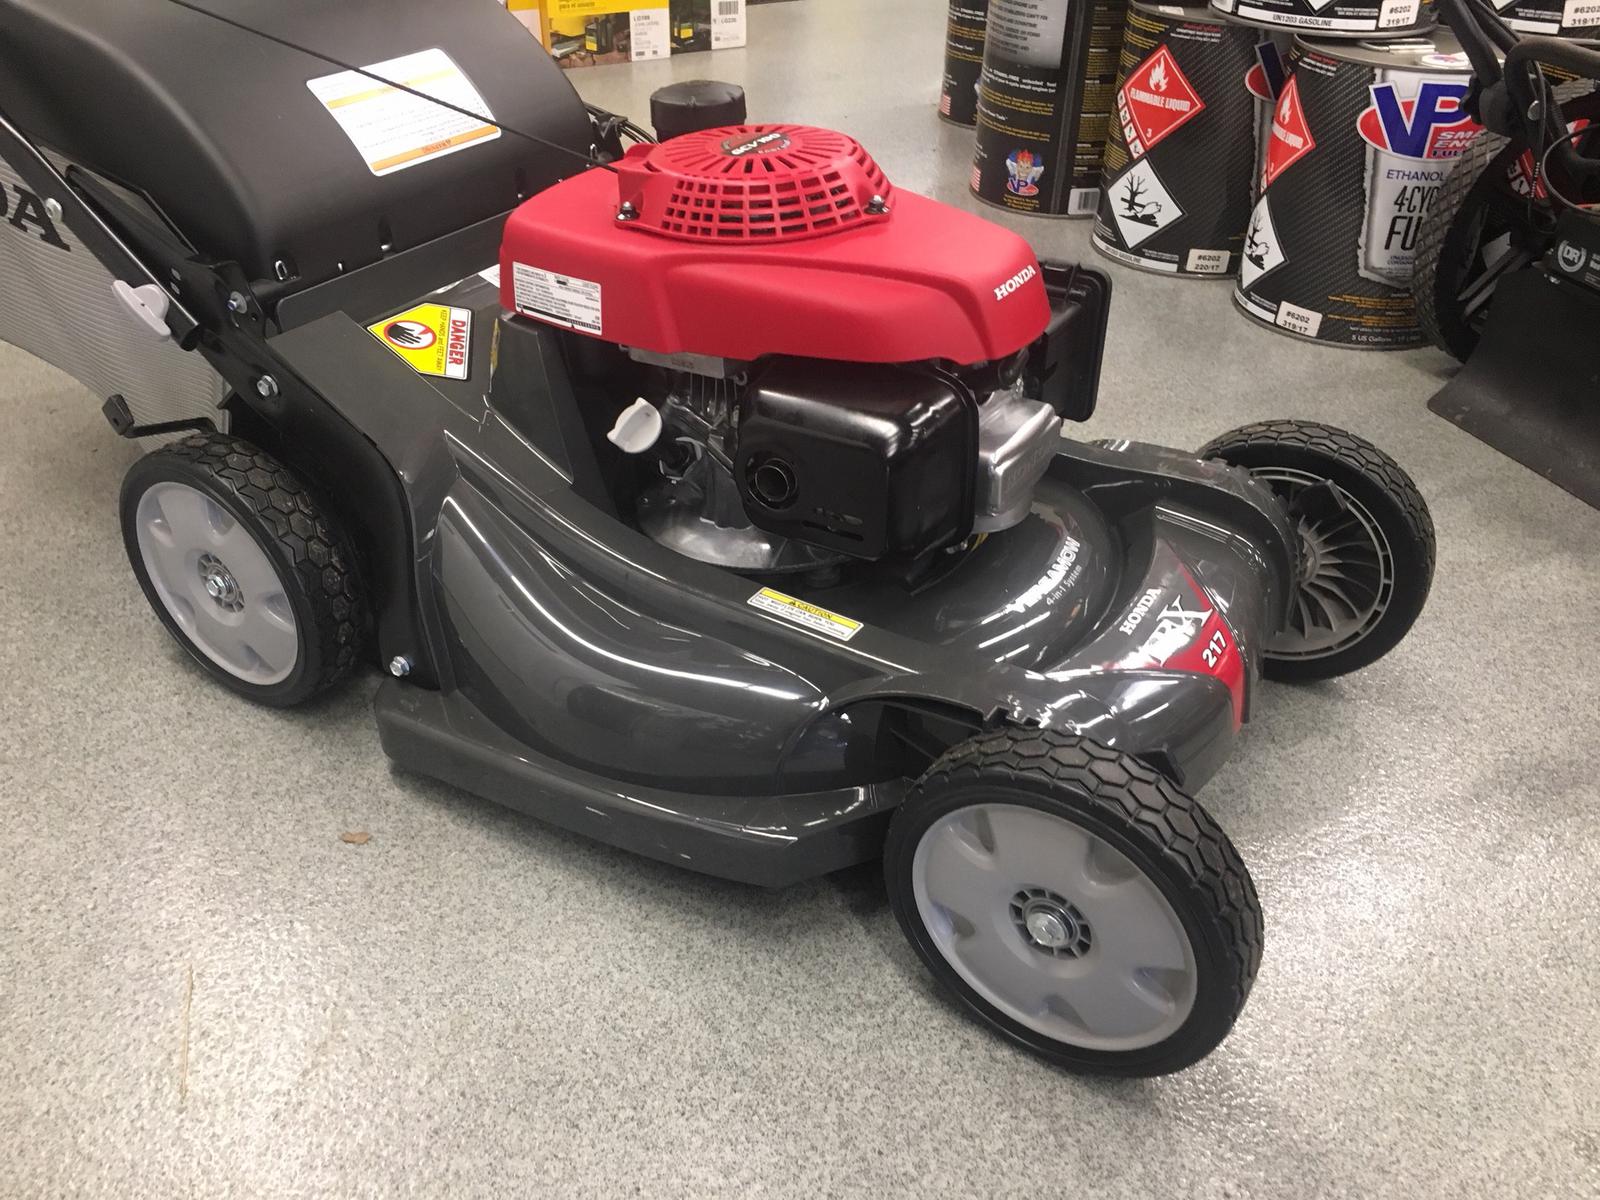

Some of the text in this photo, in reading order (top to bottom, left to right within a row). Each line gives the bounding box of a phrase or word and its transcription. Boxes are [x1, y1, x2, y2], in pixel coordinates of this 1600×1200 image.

[1272, 14, 1333, 27] UN1203 GASOLINE
[1388, 5, 1412, 14] #6202
[1369, 79, 1471, 159] VP
[1197, 254, 1221, 262] #6202
[993, 264, 1037, 301] HONDA
[1285, 310, 1310, 324] #6202
[449, 320, 466, 365] DANGER
[1063, 564, 1083, 588] System
[797, 603, 832, 620] CAUTION
[1119, 588, 1162, 636] HONDA
[1202, 629, 1227, 668] 217
